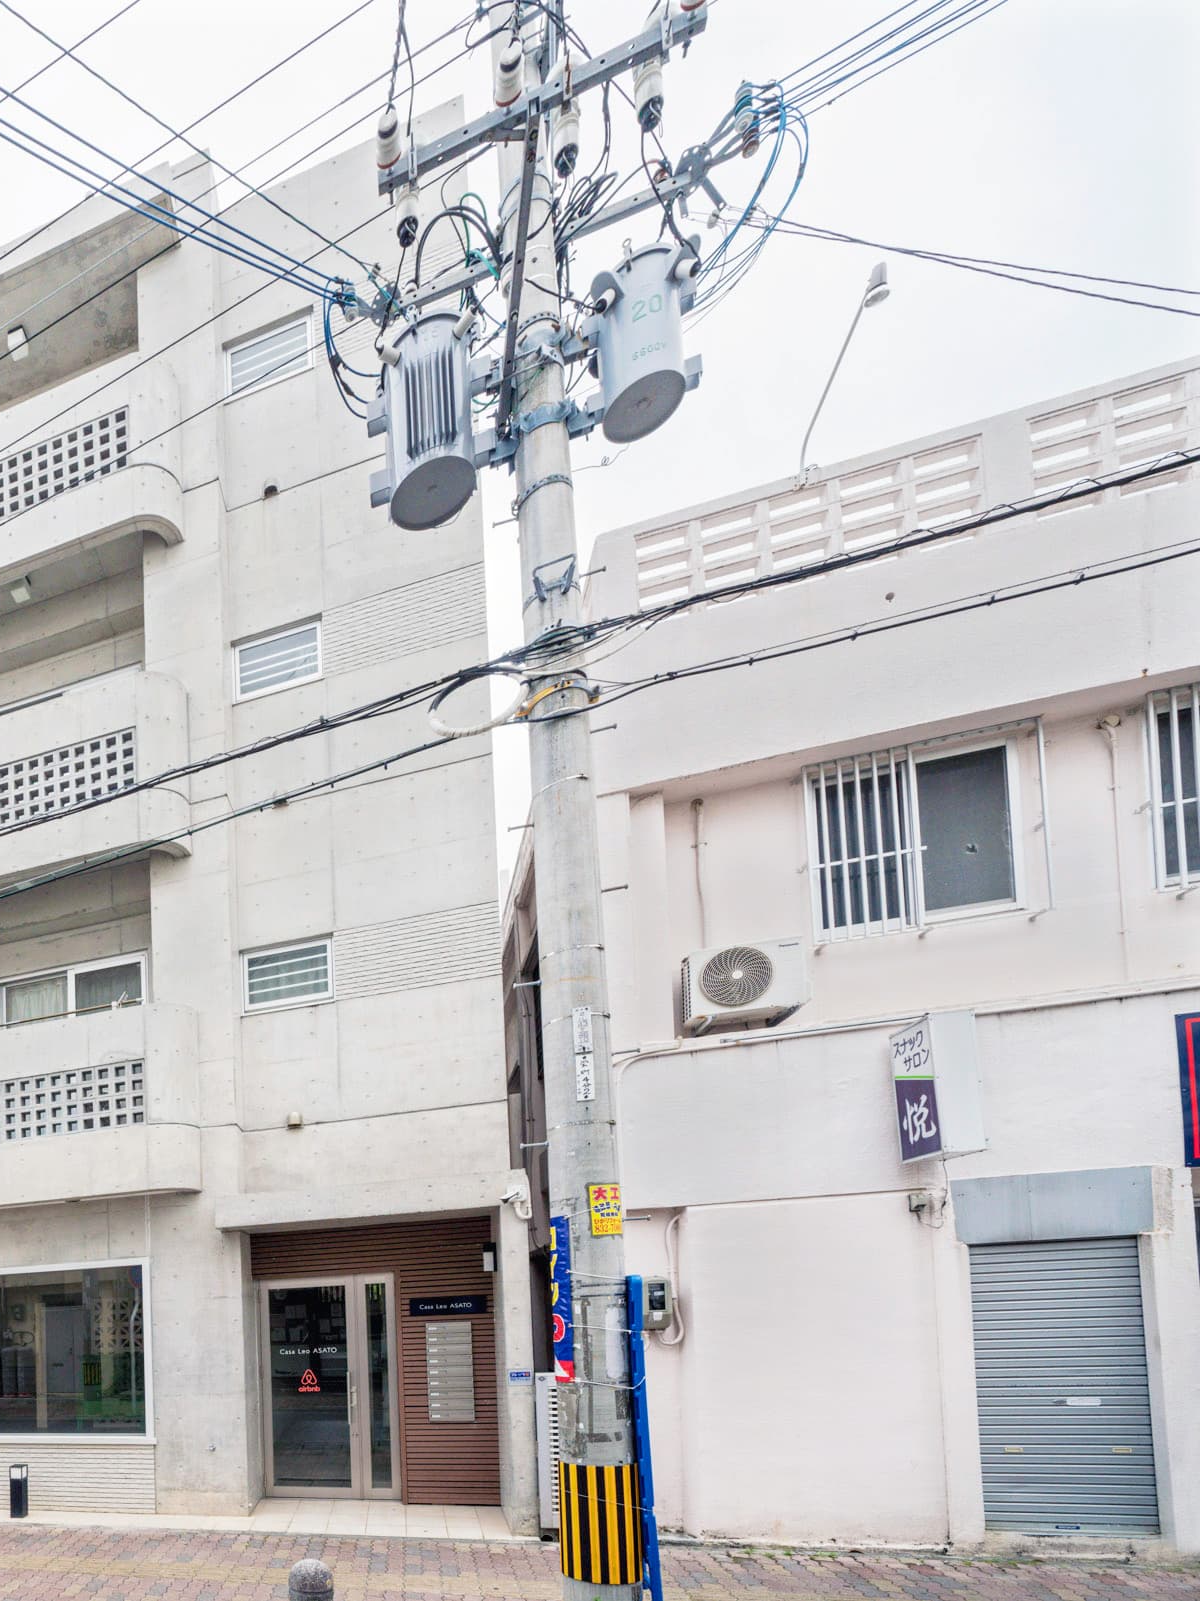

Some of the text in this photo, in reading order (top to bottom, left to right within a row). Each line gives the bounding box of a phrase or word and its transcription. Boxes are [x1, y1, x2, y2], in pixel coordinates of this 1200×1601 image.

[632, 294, 662, 322] 20
[893, 1030, 924, 1058] スナック
[903, 1048, 930, 1072] サロン
[902, 1094, 937, 1145] 悦
[592, 1186, 619, 1201] 大工
[312, 1346, 338, 1354] ASATO
